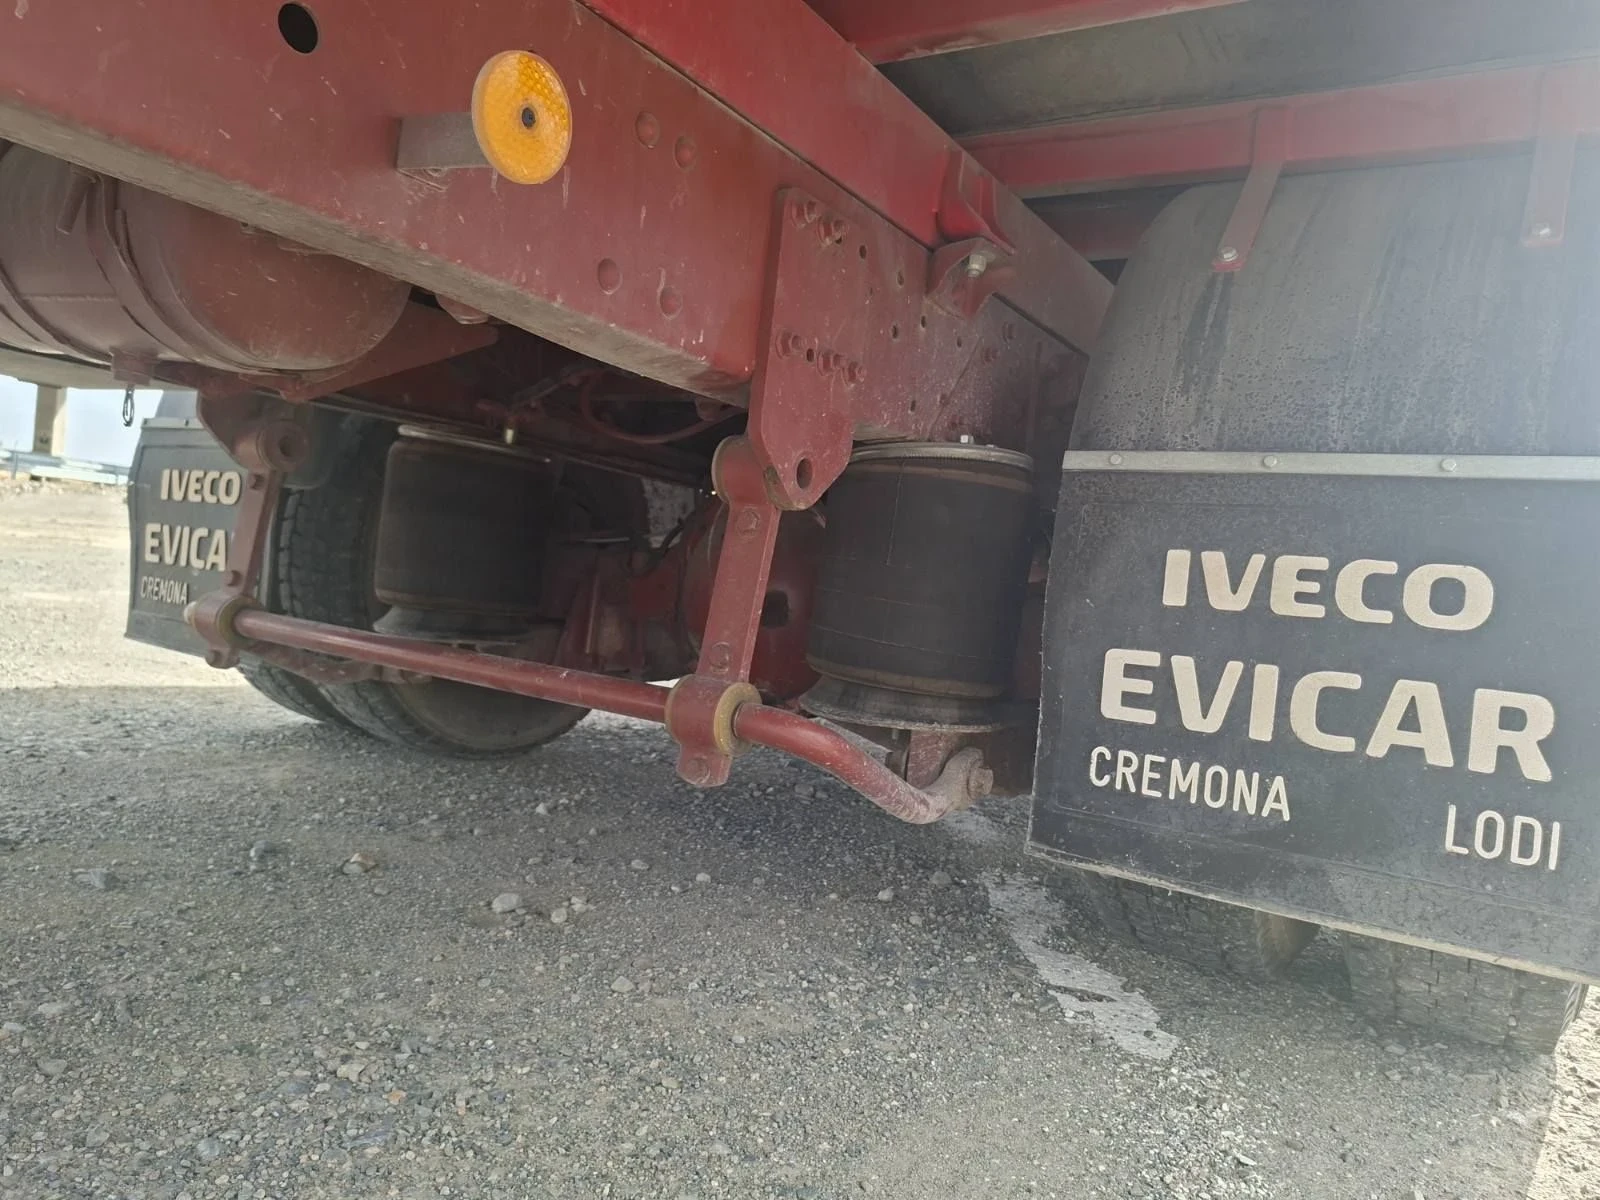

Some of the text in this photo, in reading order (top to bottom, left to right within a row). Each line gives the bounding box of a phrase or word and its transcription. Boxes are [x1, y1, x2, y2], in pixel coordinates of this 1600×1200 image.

[161, 469, 241, 505] IVECO
[144, 523, 234, 572] EVICA
[140, 575, 189, 605] CREMONA
[1162, 549, 1494, 631] IVECO
[1100, 648, 1556, 782] EVICAR
[1089, 746, 1561, 871] CREMONA LODI
